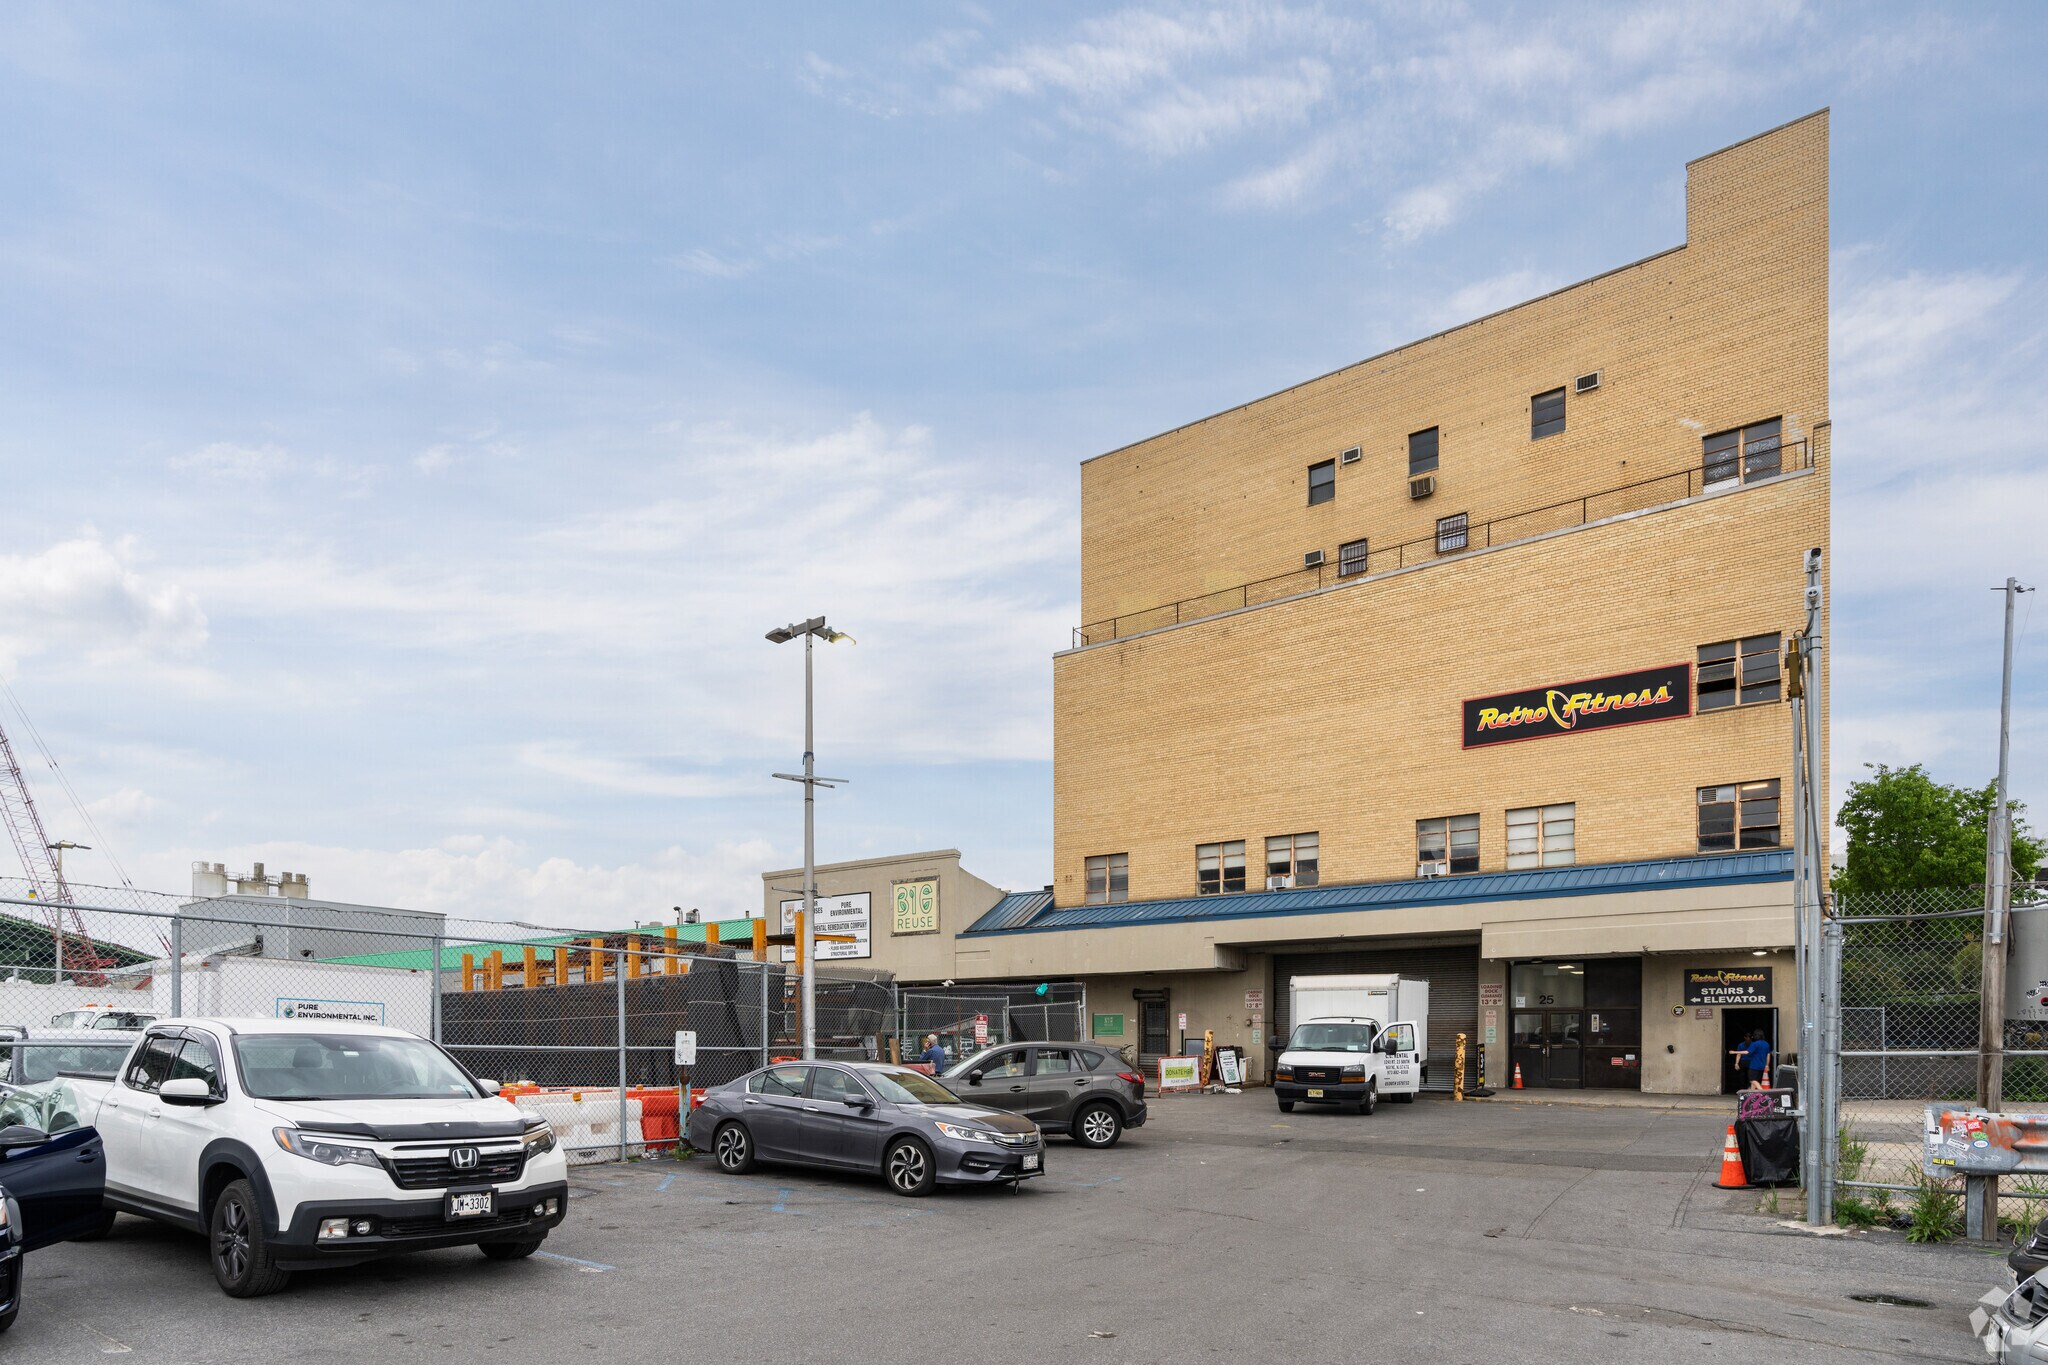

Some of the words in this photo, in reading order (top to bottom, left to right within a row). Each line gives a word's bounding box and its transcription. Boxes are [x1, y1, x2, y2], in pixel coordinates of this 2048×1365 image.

[1477, 706, 1548, 731] Retro
[1562, 685, 1674, 718] Fitness
[829, 908, 862, 916] ENVIRONMENTAL
[850, 921, 866, 930] COMPANY
[897, 916, 933, 930] REUSE
[1690, 973, 1718, 982] Retro
[1723, 972, 1766, 982] Fitness
[1538, 994, 1554, 1004] 25
[1703, 995, 1766, 1004] ELEVATOR
[297, 1011, 362, 1020] ENVIRONMENTAL
[469, 1196, 490, 1211] 3302
